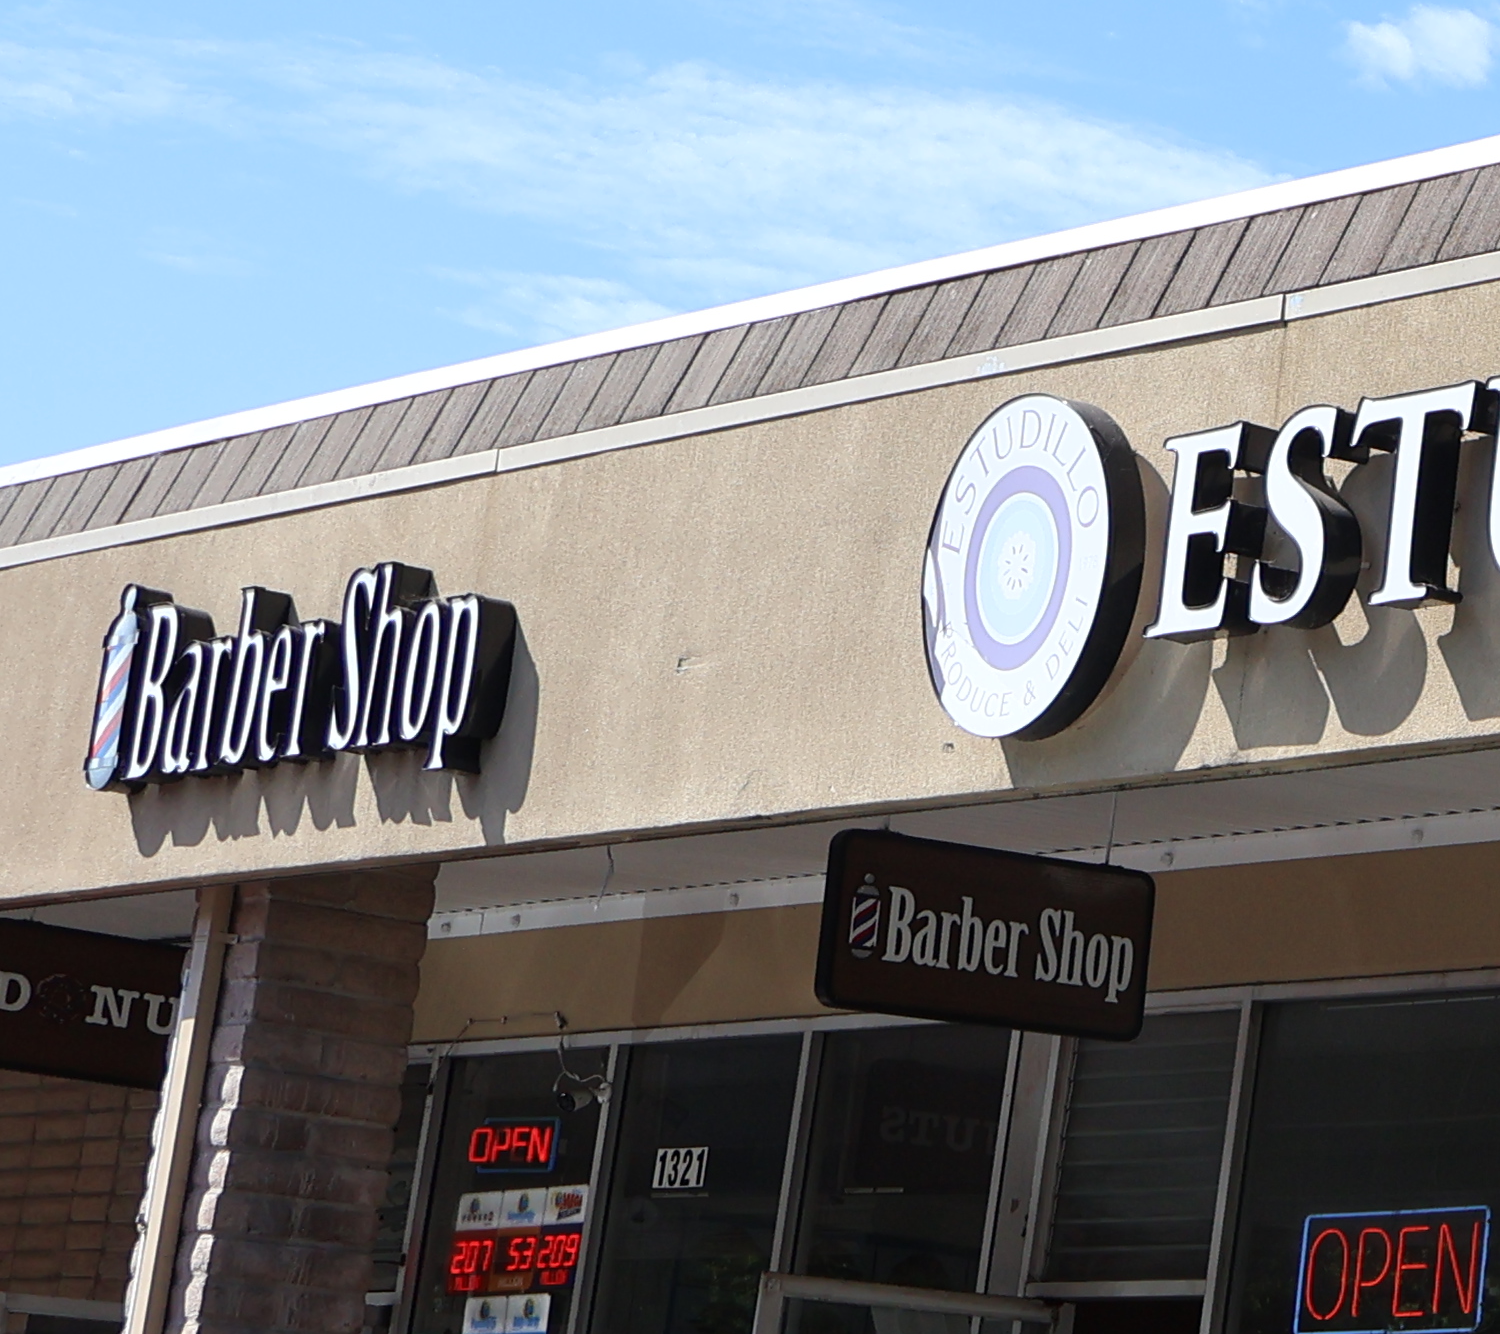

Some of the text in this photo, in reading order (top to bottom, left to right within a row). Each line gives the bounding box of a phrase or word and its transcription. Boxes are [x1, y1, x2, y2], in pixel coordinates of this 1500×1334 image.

[941, 408, 1099, 555] ESTUDILLO
[125, 562, 480, 782] Barber Shop
[940, 619, 1037, 718] PRODUCE &
[1045, 596, 1088, 681] DELI
[882, 885, 1134, 1004] Barber Shop
[657, 1150, 706, 1187] 1321
[450, 1232, 581, 1275] 207 53 209
[1304, 1221, 1482, 1322] OPEN
